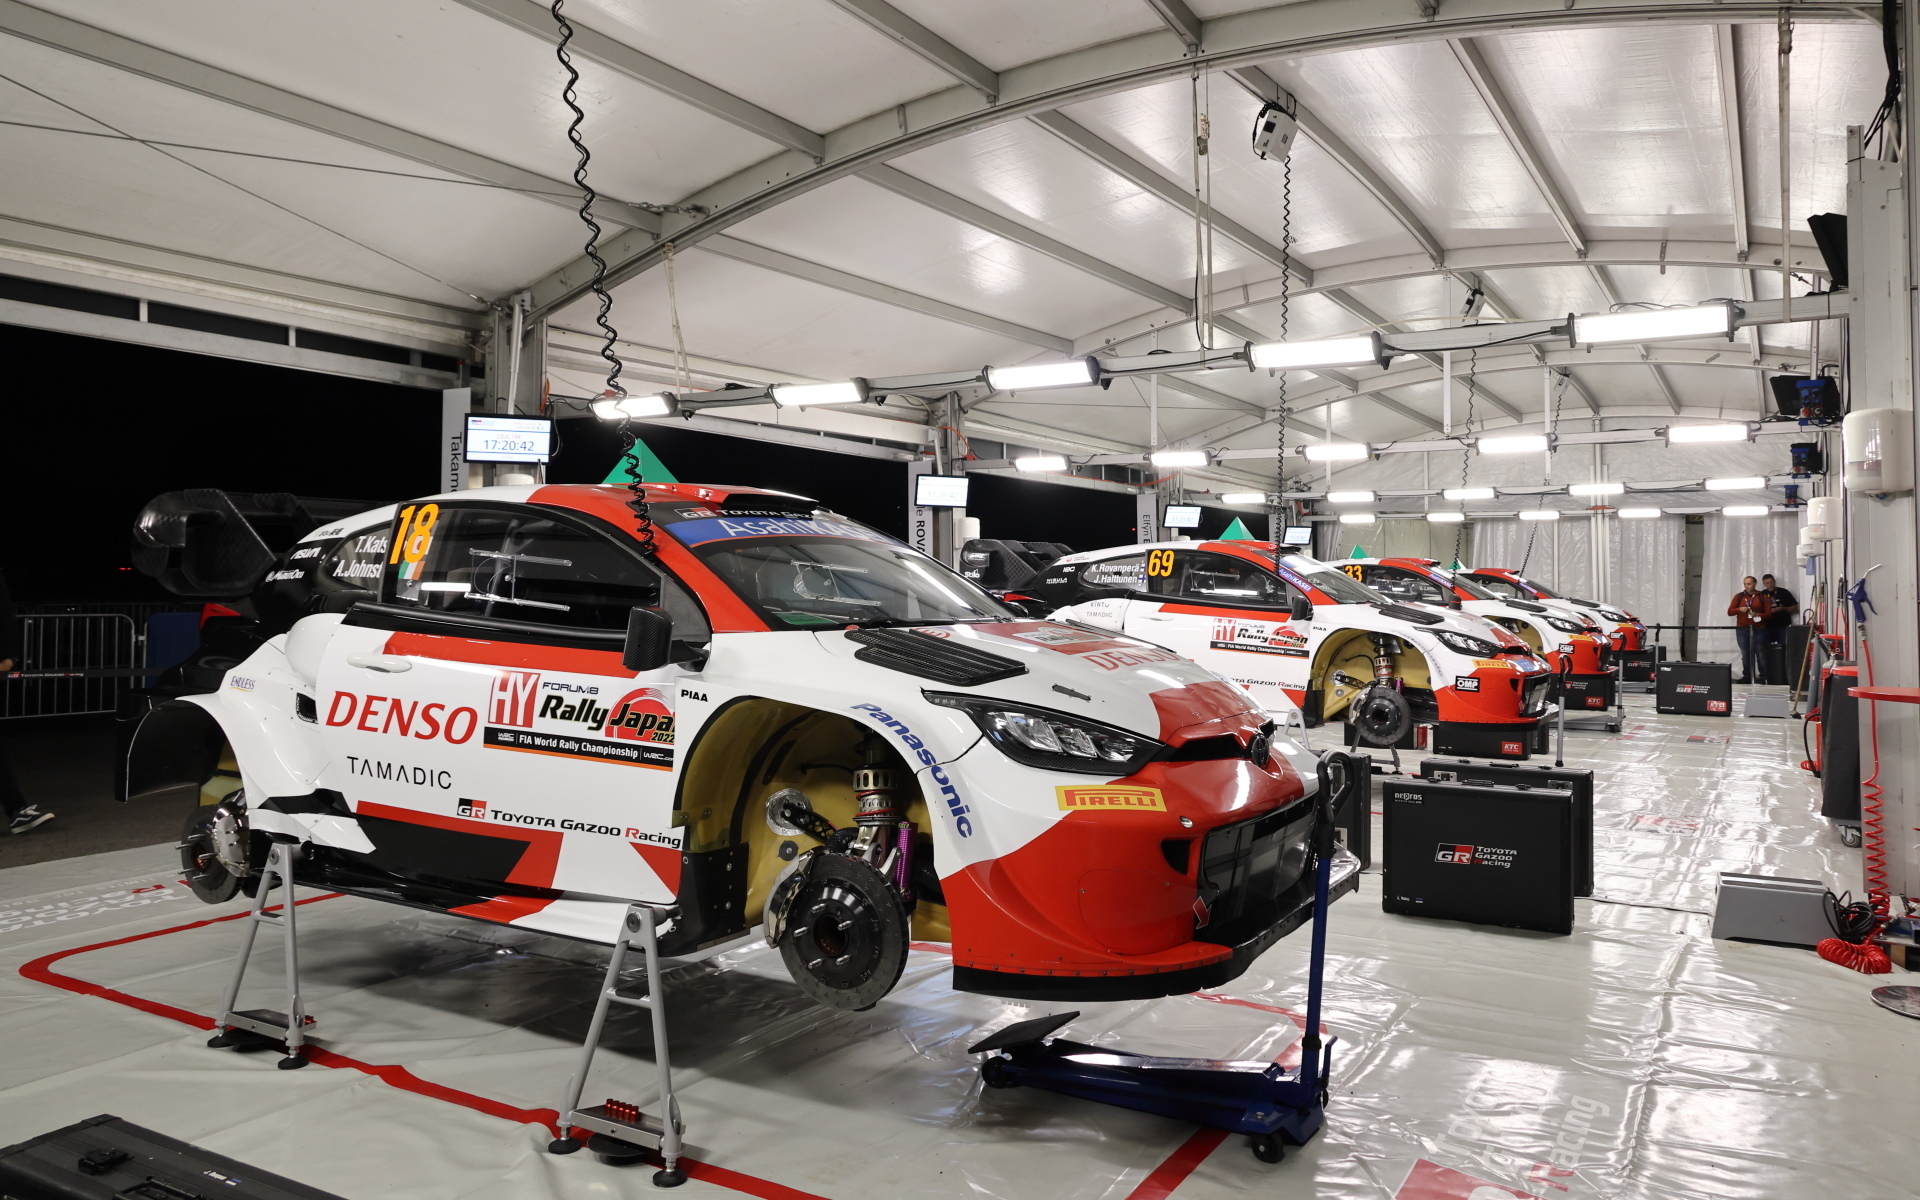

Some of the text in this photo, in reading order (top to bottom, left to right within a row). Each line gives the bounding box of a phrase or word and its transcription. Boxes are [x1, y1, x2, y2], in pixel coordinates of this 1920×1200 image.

[483, 439, 535, 452] 17:20:42
[683, 508, 716, 518] GR
[716, 508, 779, 517] TOYOTA
[389, 503, 439, 565] 18
[1142, 514, 1151, 536] Elfyn
[1091, 563, 1141, 574] K.Rovanperä
[1147, 550, 1175, 577] 69
[1093, 574, 1138, 584] J.Halttunen
[1344, 565, 1363, 582] 33
[1237, 628, 1271, 643] Rally
[1081, 650, 1181, 671] DENSO
[230, 676, 255, 691] ENDLESS
[1277, 681, 1306, 690] Racing
[1456, 679, 1479, 689] OMP
[489, 671, 540, 727] HY
[681, 689, 709, 702] PIAA
[326, 690, 479, 745] DENSO
[538, 694, 676, 738] Rally Japa
[650, 731, 675, 744] 2022
[519, 734, 638, 760] FIA World Rally Championship
[347, 756, 452, 790] TAMADIC
[850, 703, 973, 839] Panasonic
[1063, 788, 1158, 807] PIRELLI
[458, 804, 682, 849] GR TOYOTA GAZOO Racing
[1436, 845, 1518, 863] GR TOYOTA
[1475, 852, 1513, 861] GAZOO
[1474, 859, 1511, 869] Racing
[1527, 1094, 1611, 1193] Racing
